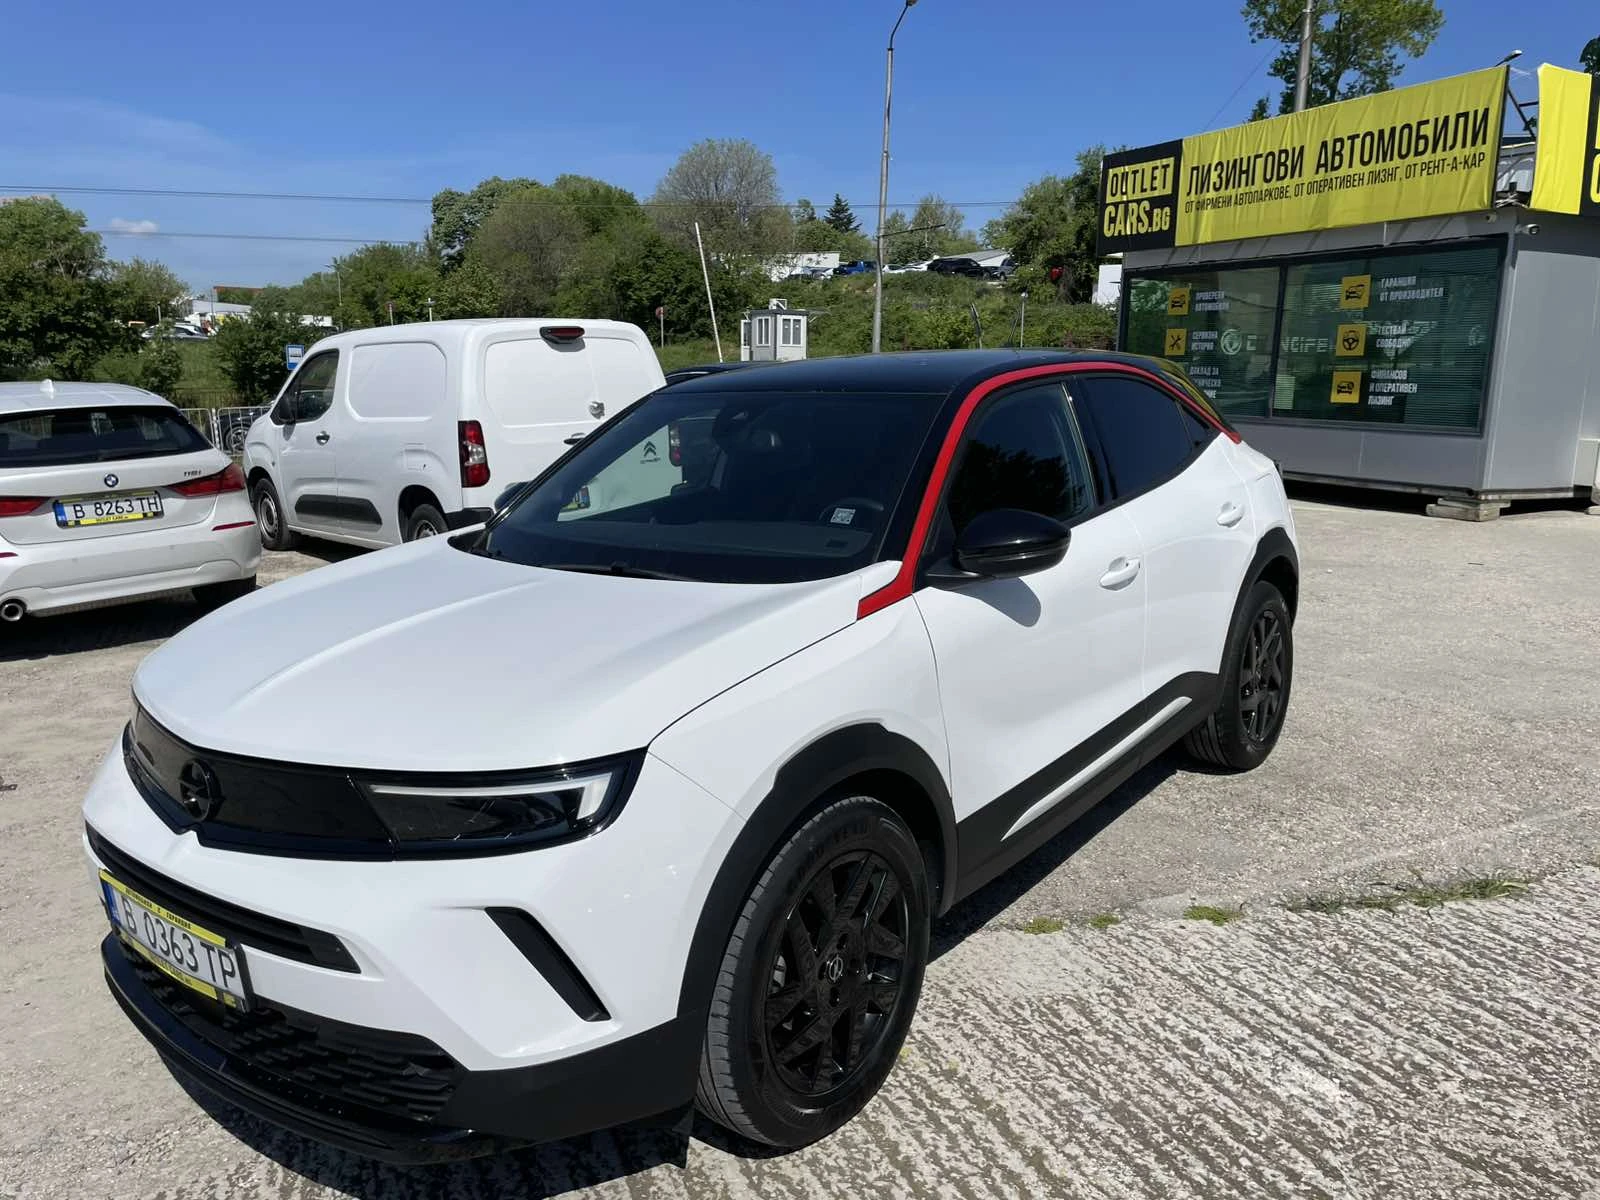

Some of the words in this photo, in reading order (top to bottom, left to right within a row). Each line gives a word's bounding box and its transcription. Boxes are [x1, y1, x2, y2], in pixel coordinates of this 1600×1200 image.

[1187, 145, 1304, 196] ЛИЗИНГОВИ
[1315, 107, 1489, 175] АВТОМОБИЛИ
[1111, 164, 1170, 197] OUTLET
[1185, 201, 1193, 213] ОТ
[1196, 195, 1232, 211] ФИРМЕНИ
[1234, 185, 1291, 206] АВТОПАРКОВЕ,
[1294, 183, 1305, 197] ОТ
[1307, 173, 1365, 195] ОПЕРАТИВЕН
[1405, 163, 1417, 179] ОТ
[1420, 152, 1485, 176] РЕНТ-А-КАР
[1104, 200, 1171, 237] CARS.BG
[73, 504, 85, 519] B
[94, 499, 134, 517] 8263
[136, 497, 158, 512] TH
[121, 895, 137, 934] B
[144, 911, 198, 972] 0363
[200, 942, 236, 988] TP
